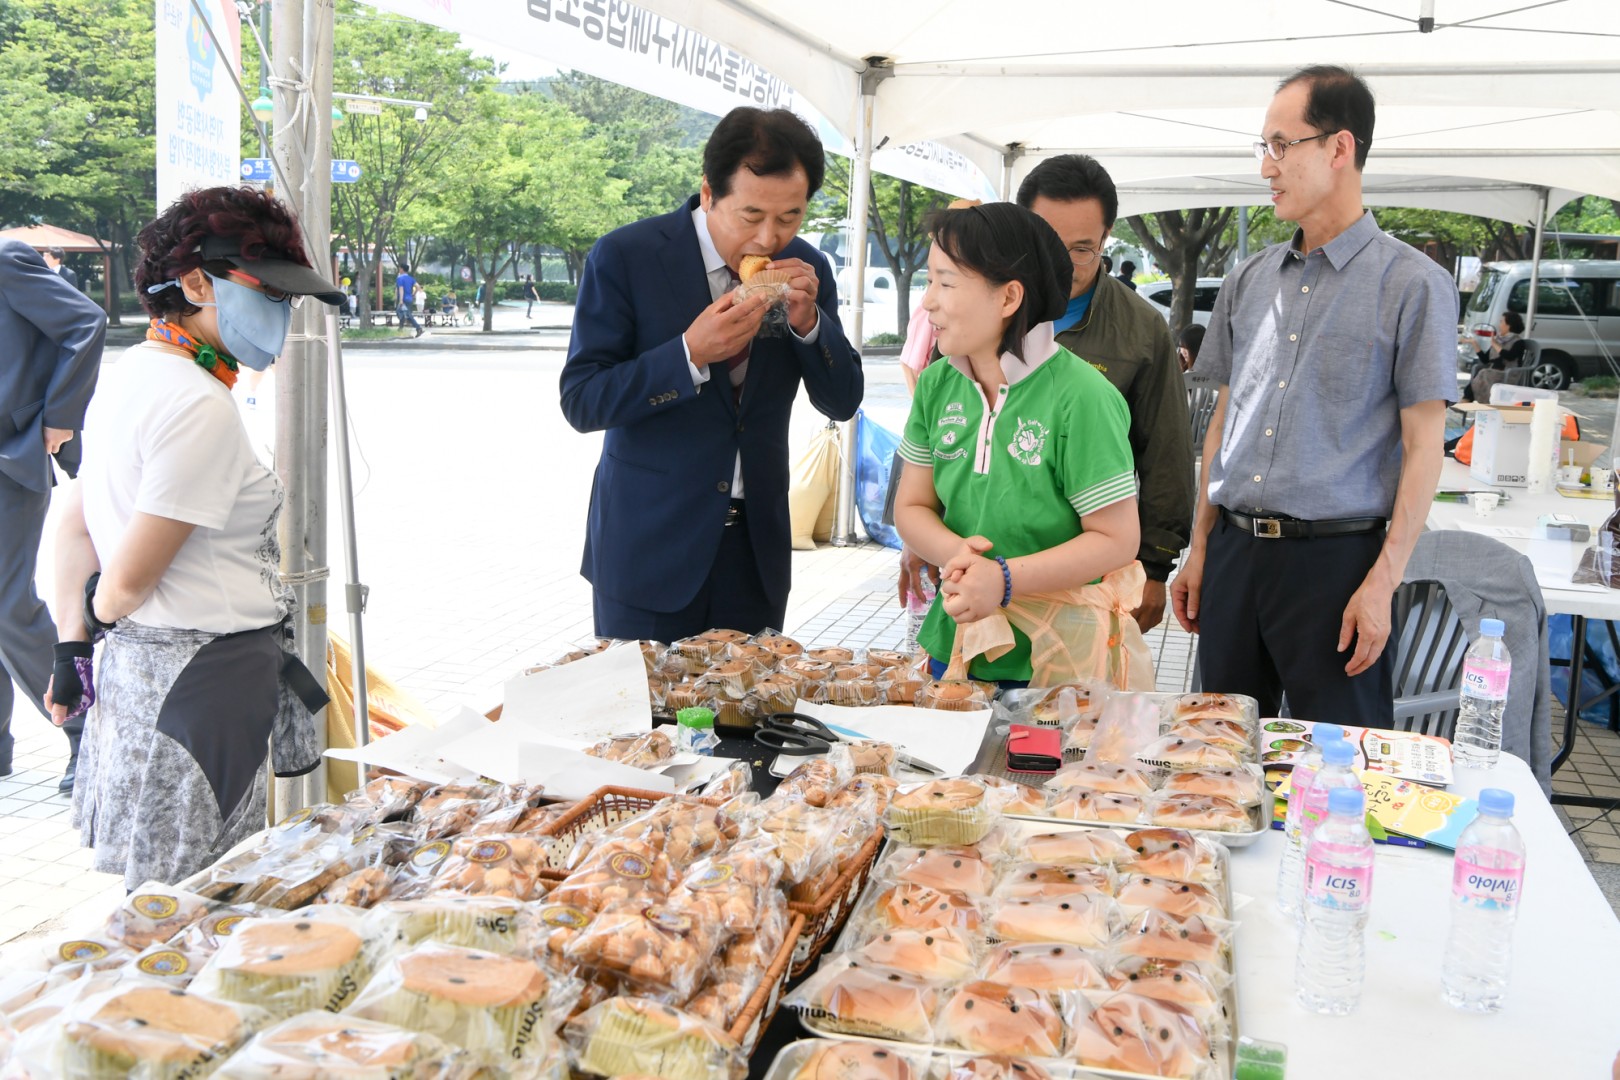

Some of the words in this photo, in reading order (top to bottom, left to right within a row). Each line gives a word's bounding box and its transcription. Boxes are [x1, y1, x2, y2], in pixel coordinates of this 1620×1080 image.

[1465, 671, 1485, 684] ICIS
[1325, 874, 1357, 890] ICIS
[1468, 874, 1517, 893] 아이시스
[1348, 890, 1361, 898] 8.0
